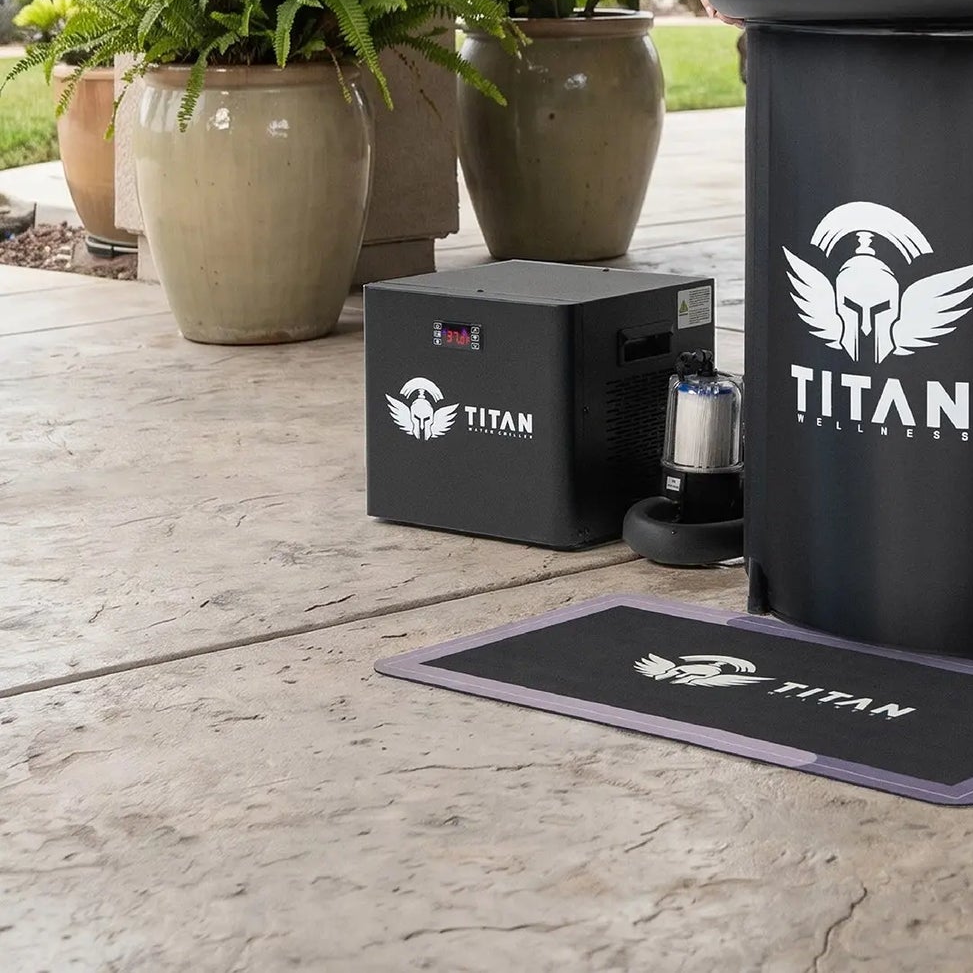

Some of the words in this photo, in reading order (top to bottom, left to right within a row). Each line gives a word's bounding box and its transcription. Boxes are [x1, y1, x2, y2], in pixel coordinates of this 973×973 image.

[791, 364, 970, 430] TITAN
[464, 405, 533, 434] TITAN
[797, 413, 969, 442] WELLNESS
[773, 681, 917, 718] TITAN
